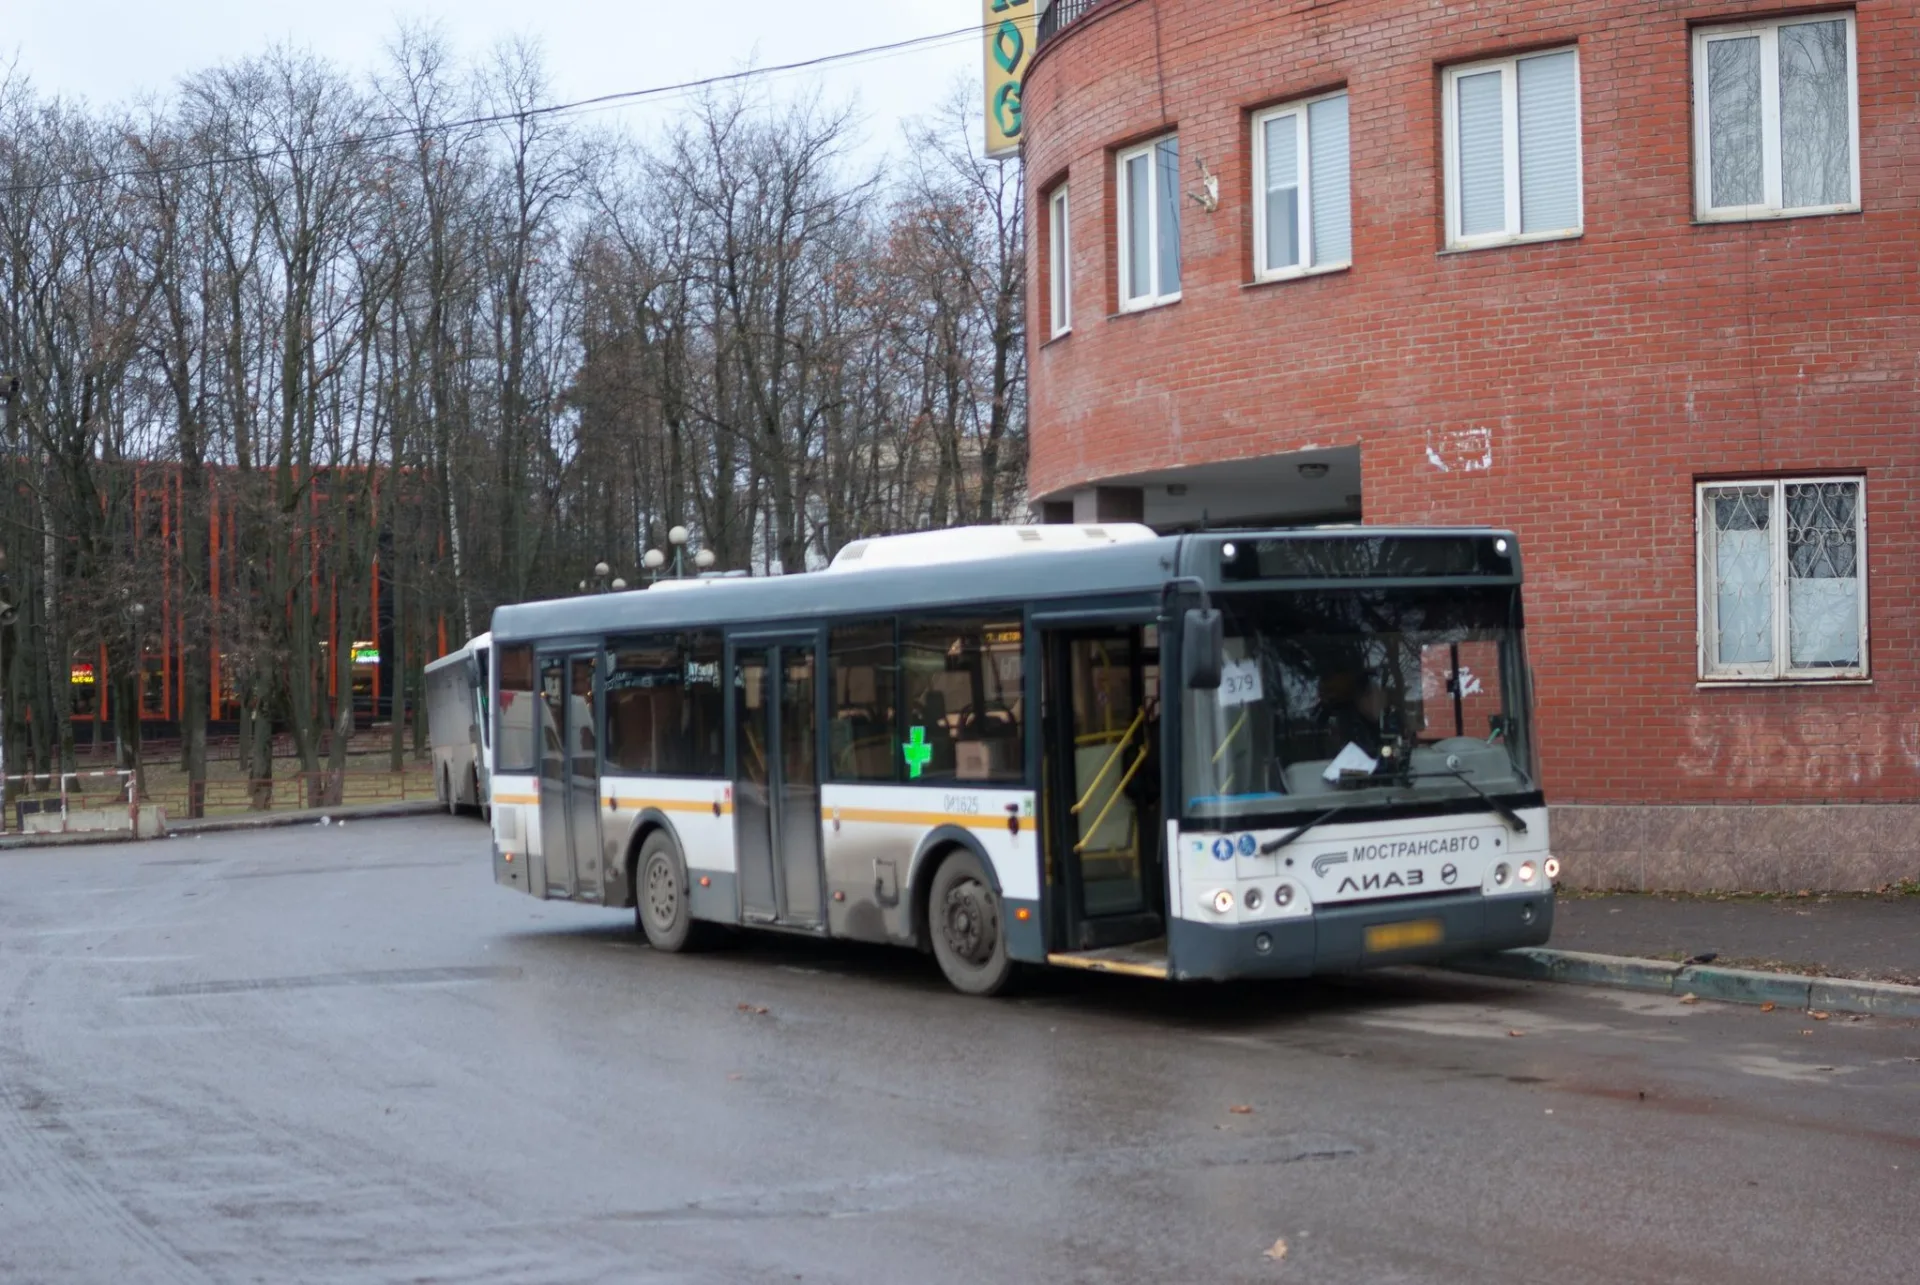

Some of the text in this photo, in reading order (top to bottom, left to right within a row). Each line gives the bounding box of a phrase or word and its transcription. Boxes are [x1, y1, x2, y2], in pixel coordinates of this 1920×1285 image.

[1226, 674, 1253, 694] 379
[1352, 835, 1480, 862] МОСТРАНСАВТО
[1336, 869, 1424, 894] ЛИАЗ
